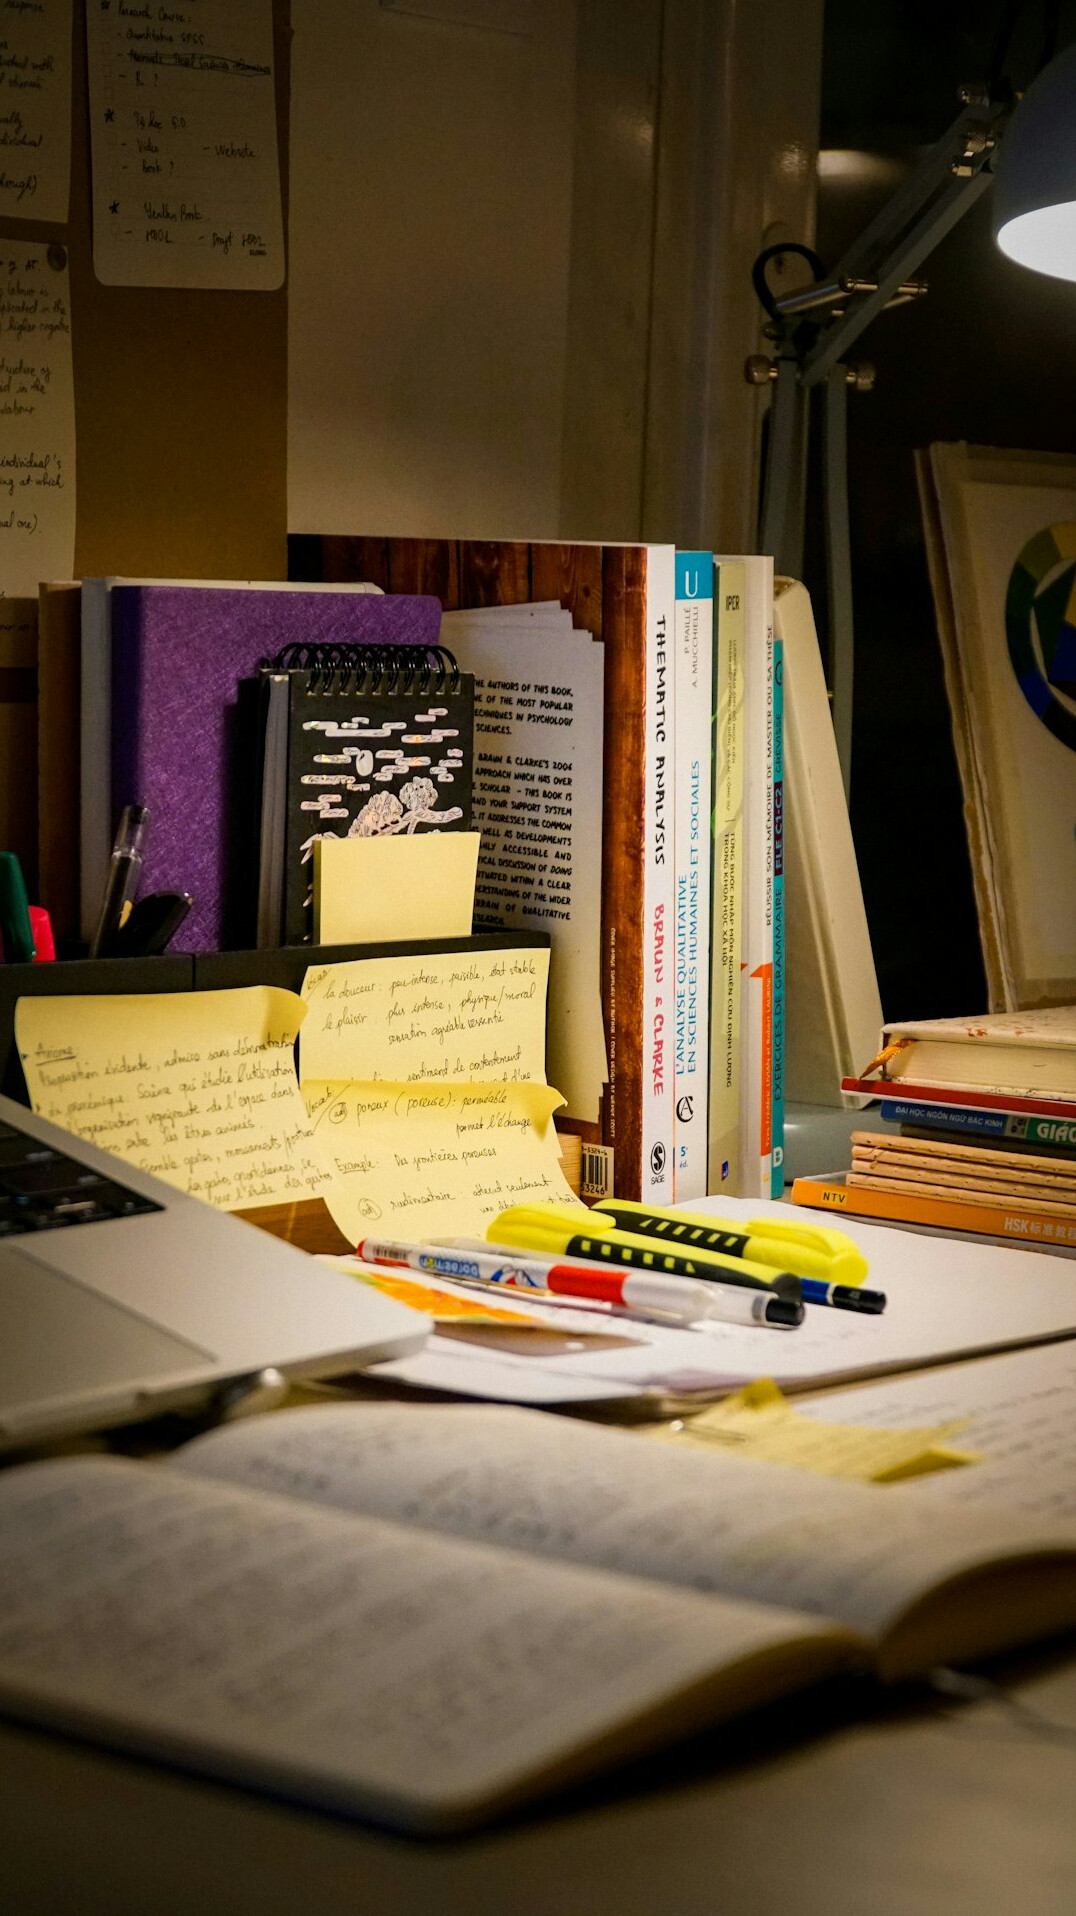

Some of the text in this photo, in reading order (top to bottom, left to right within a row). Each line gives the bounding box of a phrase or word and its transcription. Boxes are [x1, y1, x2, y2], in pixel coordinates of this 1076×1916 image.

[685, 570, 698, 597] U
[726, 595, 739, 610] IPER
[766, 666, 772, 681] SA
[488, 680, 573, 697] AUTHORS OF THIS BOOK,
[766, 687, 772, 705] OU
[487, 695, 573, 710] OF THE MOST POPULAR
[516, 713, 573, 726] IN PSYCHOLOGY
[476, 724, 512, 734] SCIENCES.
[655, 616, 666, 865] THEMATIC ANALYSIS
[478, 753, 572, 770] BRAUN & CLARKE'S 2006
[476, 768, 572, 786] APPROACH WHICH HAS OVER
[766, 764, 772, 778] DE
[480, 783, 572, 801] SCHOLAR THIS BOOK IS
[490, 799, 508, 808] YOUR
[512, 801, 540, 812] SUPPORT
[545, 805, 572, 816] SYSTEM
[488, 813, 525, 824] ADDRESSES
[527, 818, 540, 826] THE
[542, 820, 572, 830] COMMON
[483, 828, 572, 846] WELL AS DEVELOPMENTS
[503, 844, 571, 860] ACCESSIBLE AND
[775, 839, 783, 868] FLE
[498, 858, 535, 870] DISCUSSION
[550, 866, 572, 875] DOING
[511, 875, 534, 885] WITHIN
[547, 880, 571, 890] CLEAR
[534, 892, 547, 901] THE
[550, 895, 571, 905] WIDER
[522, 905, 570, 920] QUALITATIVE
[688, 761, 699, 1072] EN SCIENCES HUMAINES ET SOCIALES
[775, 889, 783, 989] GRAMMAIRE
[510, 959, 536, 974] stable
[676, 875, 686, 1075] L'ANALYSE QUALITATIVE
[653, 904, 664, 1096] BRAUN & CLARKE
[775, 994, 782, 1014] DE
[927, 1110, 948, 1120] NGÔN
[985, 1118, 1003, 1128] KINH
[651, 1175, 664, 1185] SAGE
[824, 1192, 846, 1203] NTV
[1005, 1217, 1029, 1232] HSK
